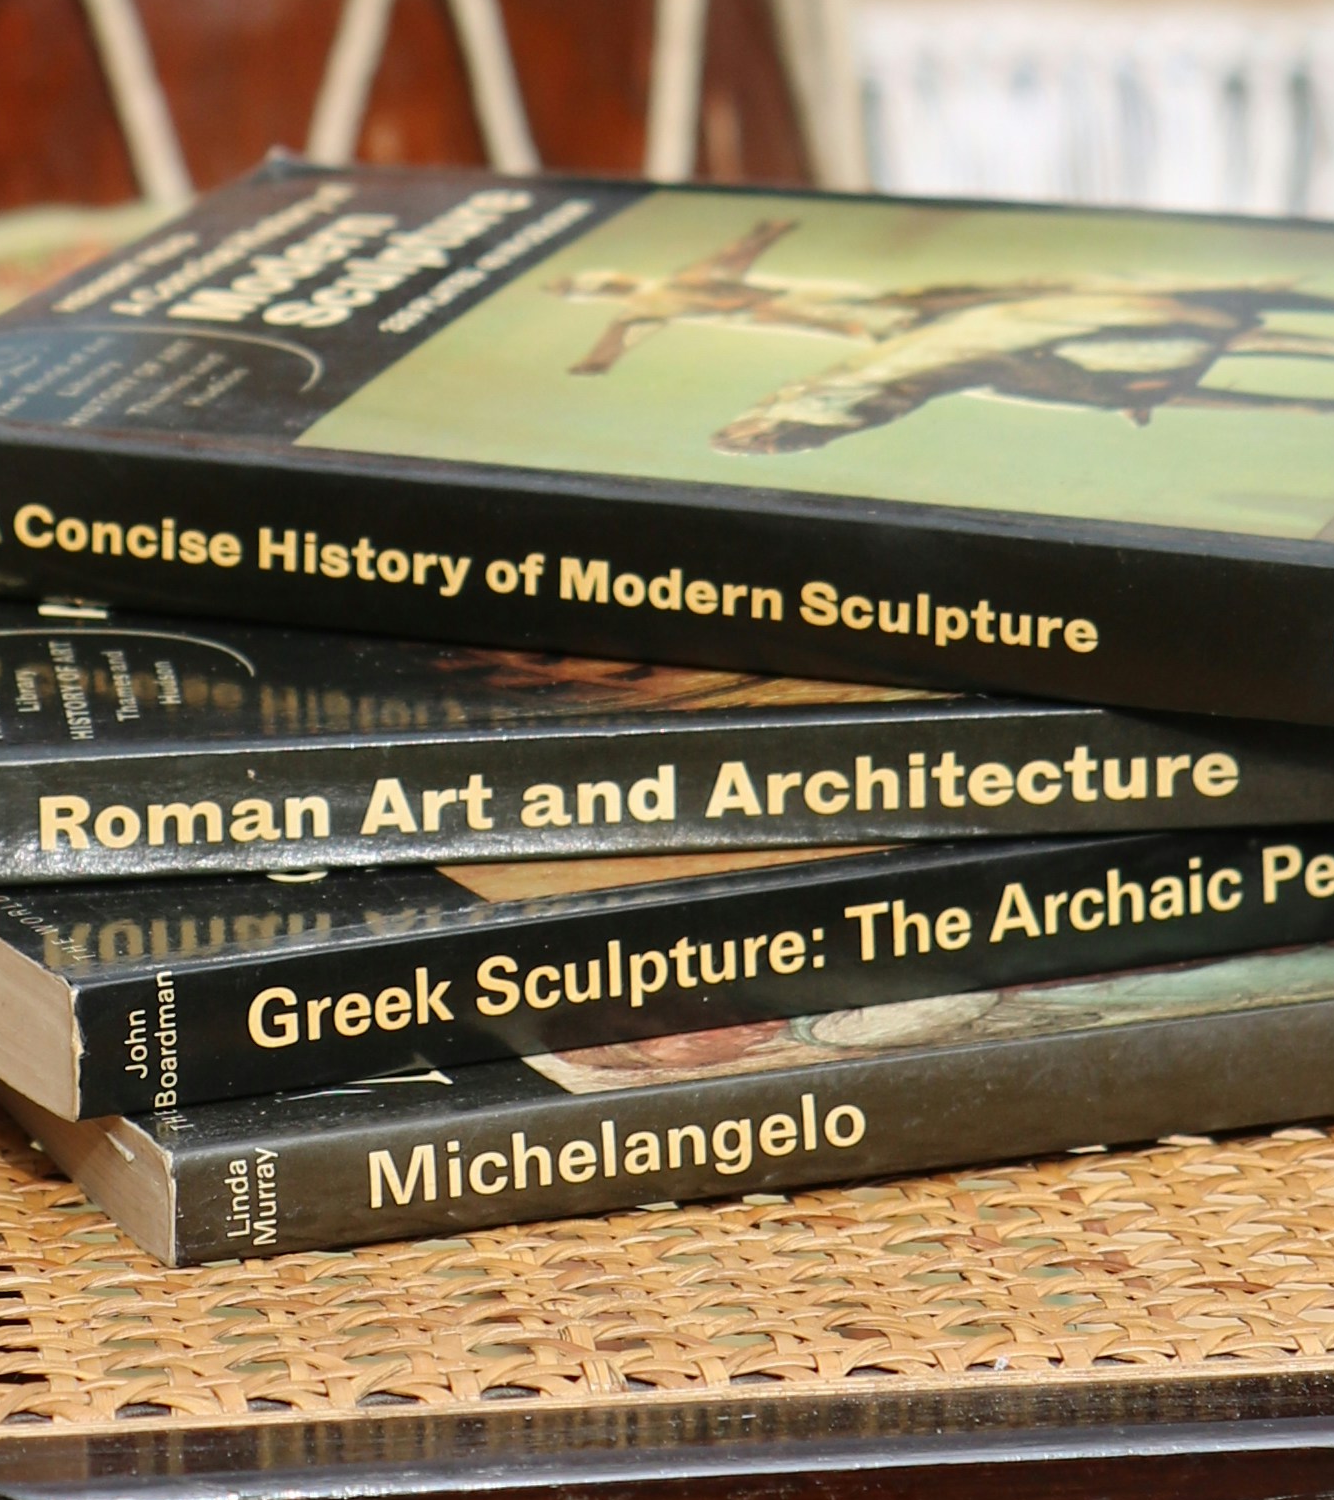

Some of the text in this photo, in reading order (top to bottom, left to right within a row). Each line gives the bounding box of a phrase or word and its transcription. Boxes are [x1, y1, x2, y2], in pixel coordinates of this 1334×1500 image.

[167, 213, 399, 322] Modern
[262, 190, 533, 328] Sculpture
[13, 504, 243, 568] Concise
[258, 527, 471, 598] History
[485, 552, 545, 596] of
[559, 557, 783, 621] Modern
[799, 580, 1099, 654] Sculpture
[15, 669, 41, 713] Library
[48, 641, 95, 740] HISTORY OF ART
[100, 650, 140, 723] Thames and
[153, 660, 183, 705] Hudson
[38, 746, 1239, 852] Roman Art and Architecture
[247, 966, 455, 1048] Greek
[476, 927, 826, 1016] Sculpture:
[844, 898, 971, 962] The
[988, 856, 1244, 944] Archaic
[124, 1008, 149, 1080] John
[154, 970, 178, 1108] Boardman
[226, 1158, 251, 1238] Linda
[252, 1147, 281, 1247] Murray
[368, 1093, 867, 1210] Michelangelo
